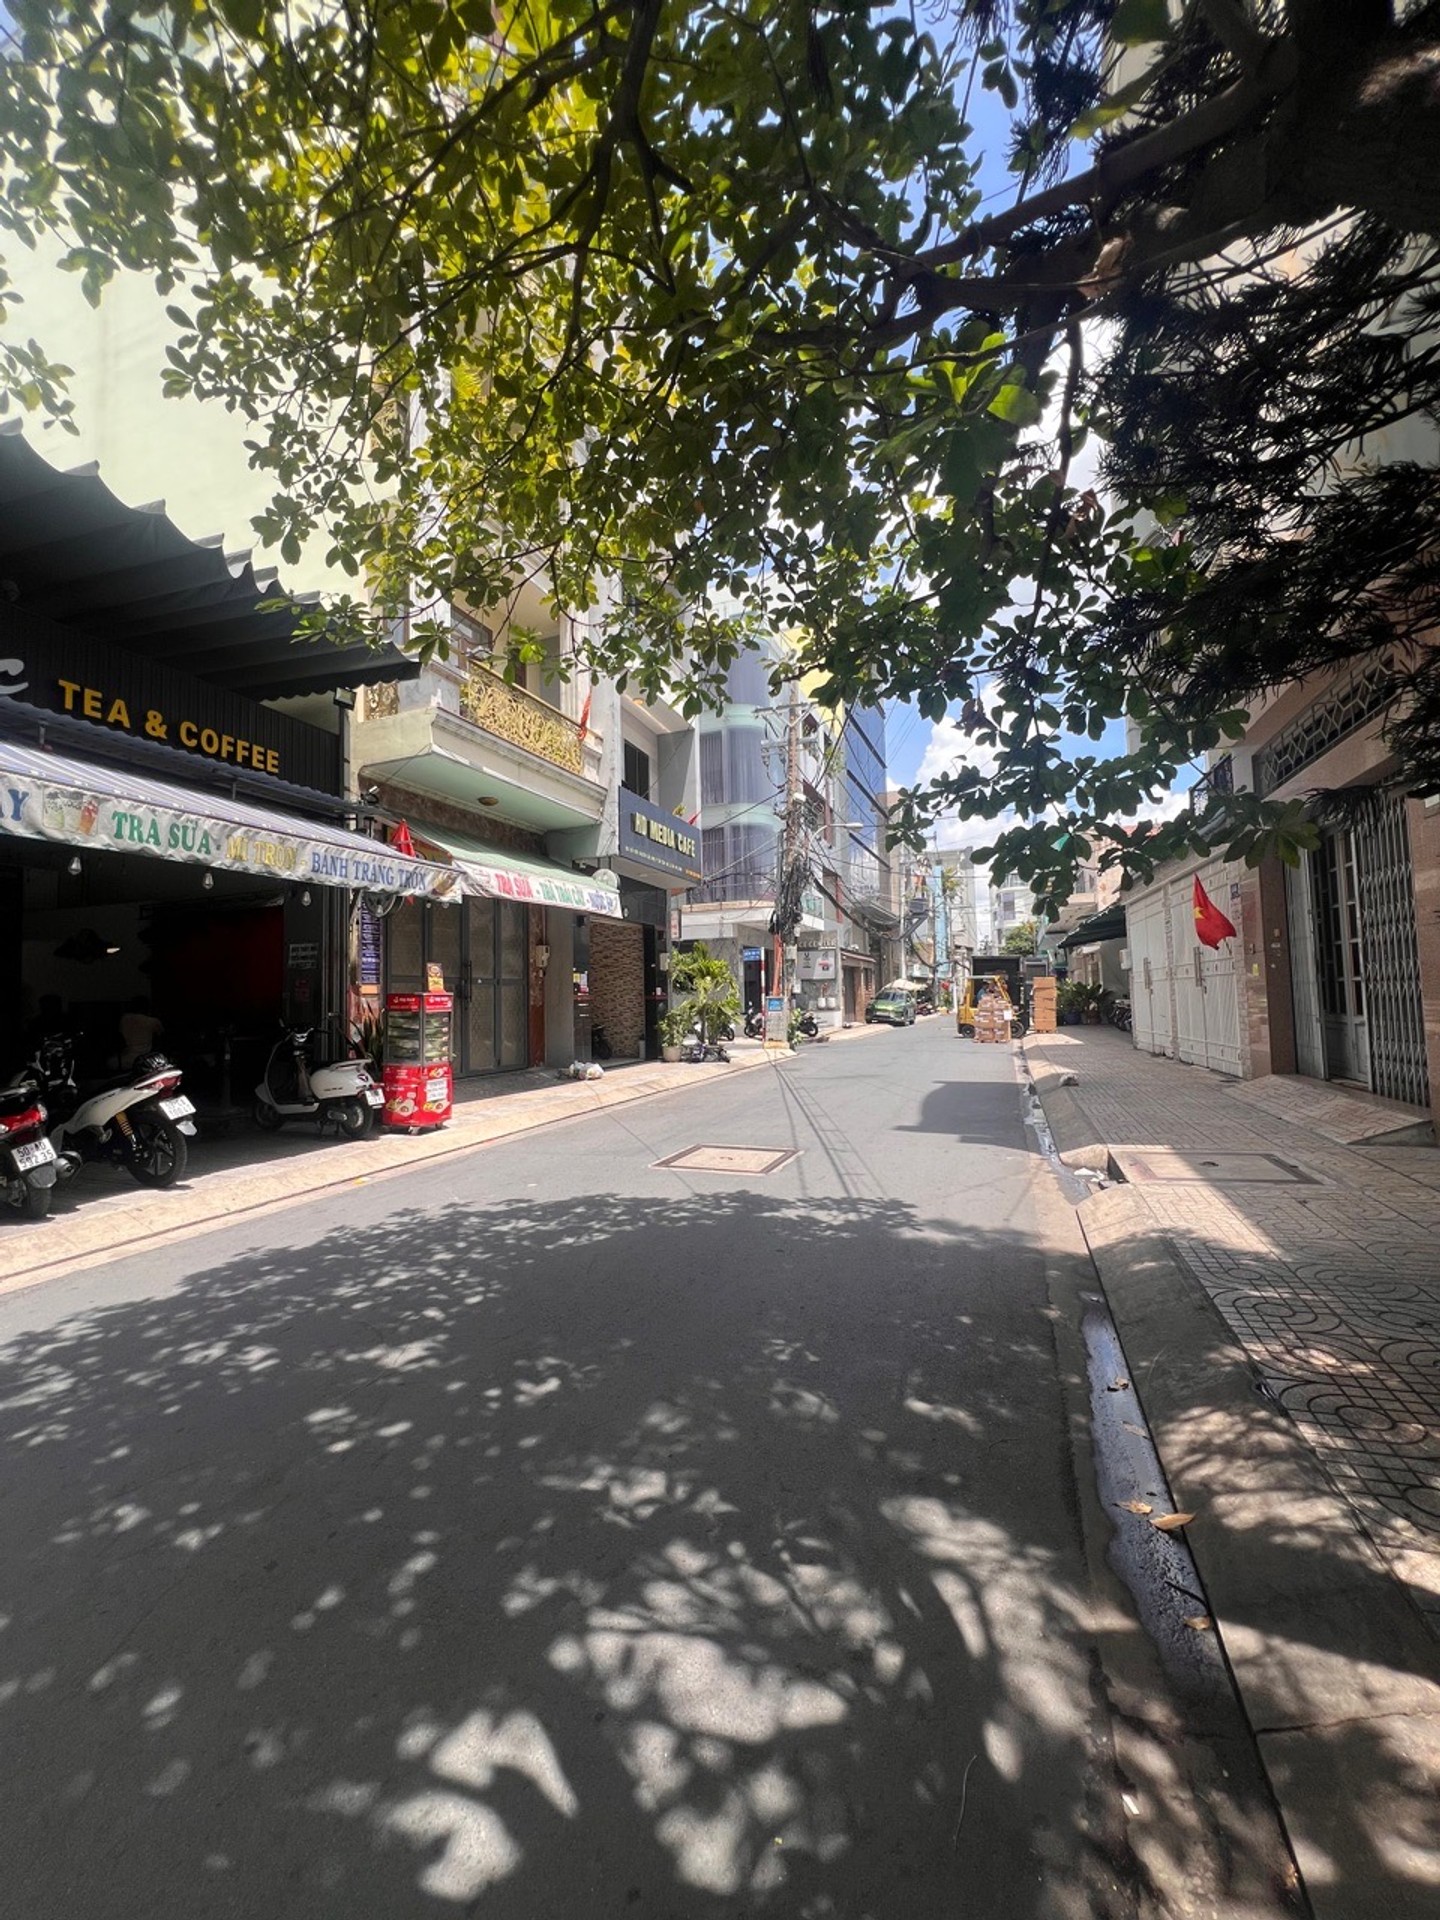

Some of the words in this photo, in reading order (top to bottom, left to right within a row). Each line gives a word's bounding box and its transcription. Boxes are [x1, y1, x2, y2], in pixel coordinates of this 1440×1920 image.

[58, 679, 131, 729] TEA
[145, 710, 168, 739] &
[180, 721, 279, 773] COFFEE
[649, 819, 676, 849] MEDIA
